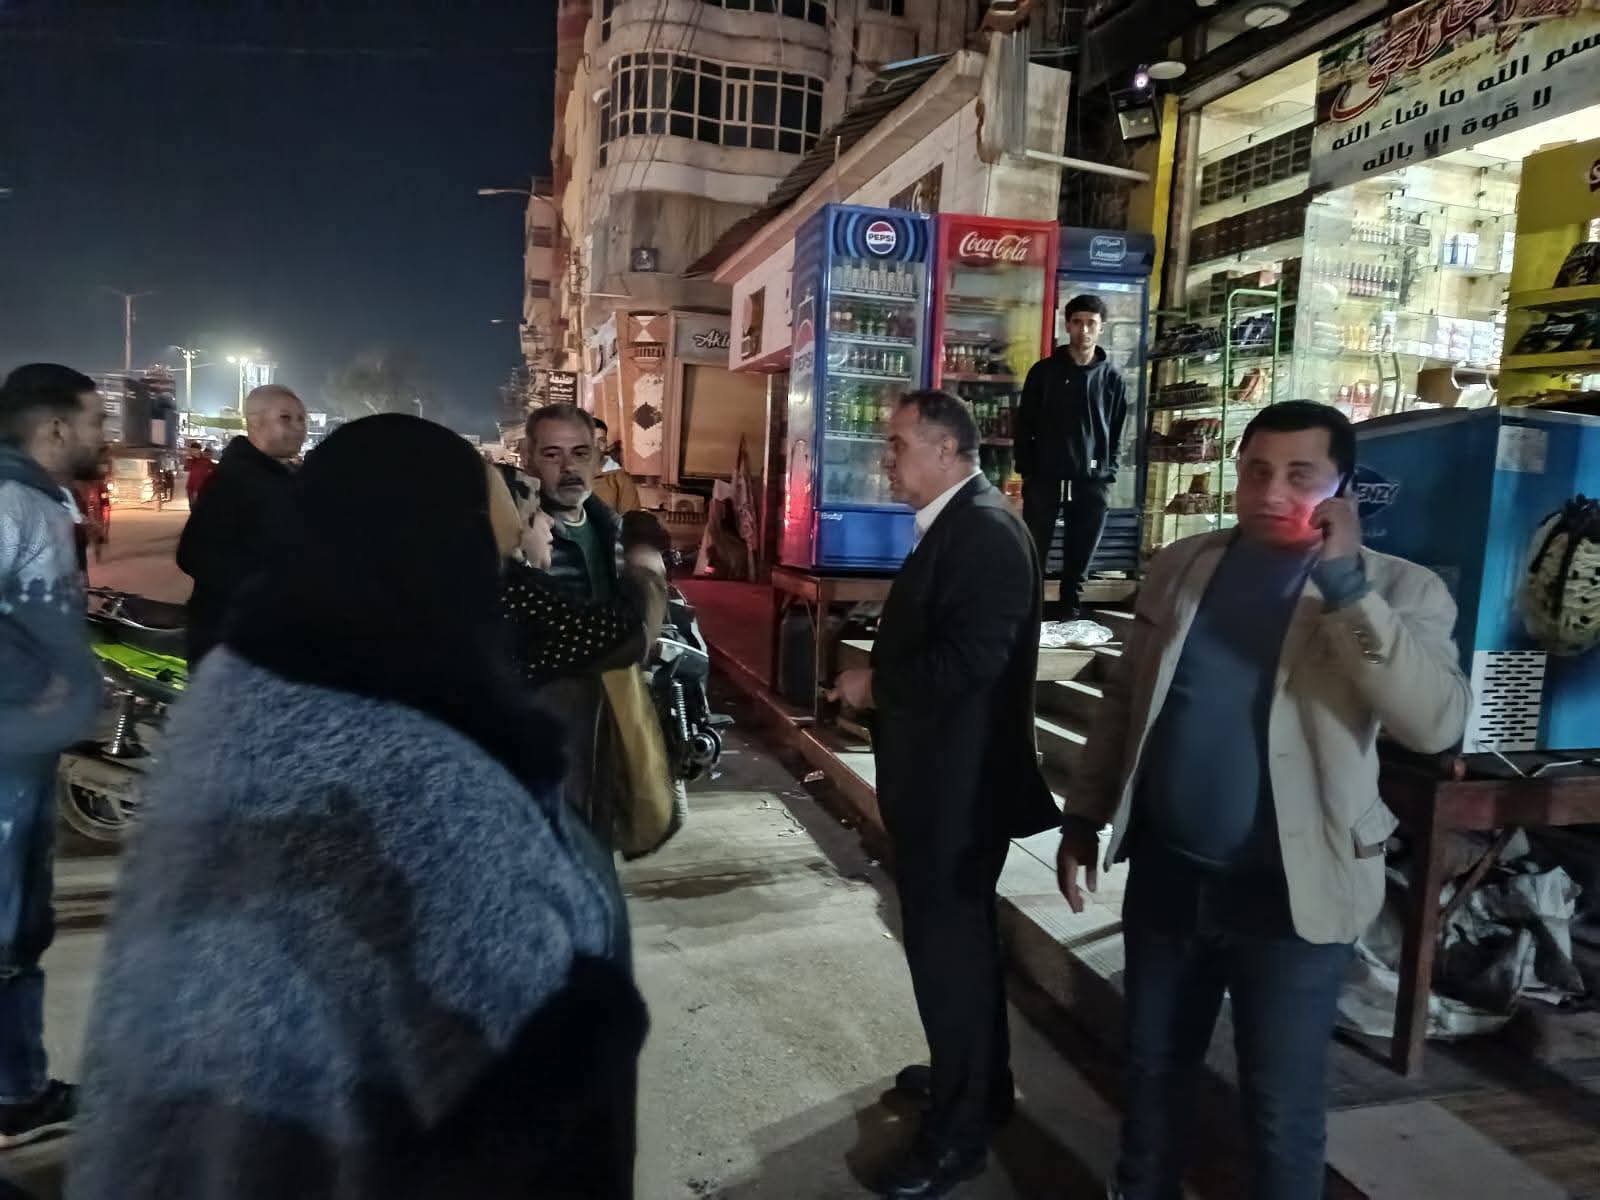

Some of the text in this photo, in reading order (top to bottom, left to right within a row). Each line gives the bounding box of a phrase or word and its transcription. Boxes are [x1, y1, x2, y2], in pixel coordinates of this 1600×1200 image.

[1542, 33, 1600, 72] سم
[1477, 54, 1530, 92] الله
[1440, 89, 1465, 107] ما
[1532, 86, 1552, 110] لا
[1379, 100, 1428, 130] شاء
[1461, 102, 1519, 135] قوة
[1332, 121, 1370, 150] الله
[1362, 141, 1414, 171] بالله
[867, 232, 894, 242] PEPSI
